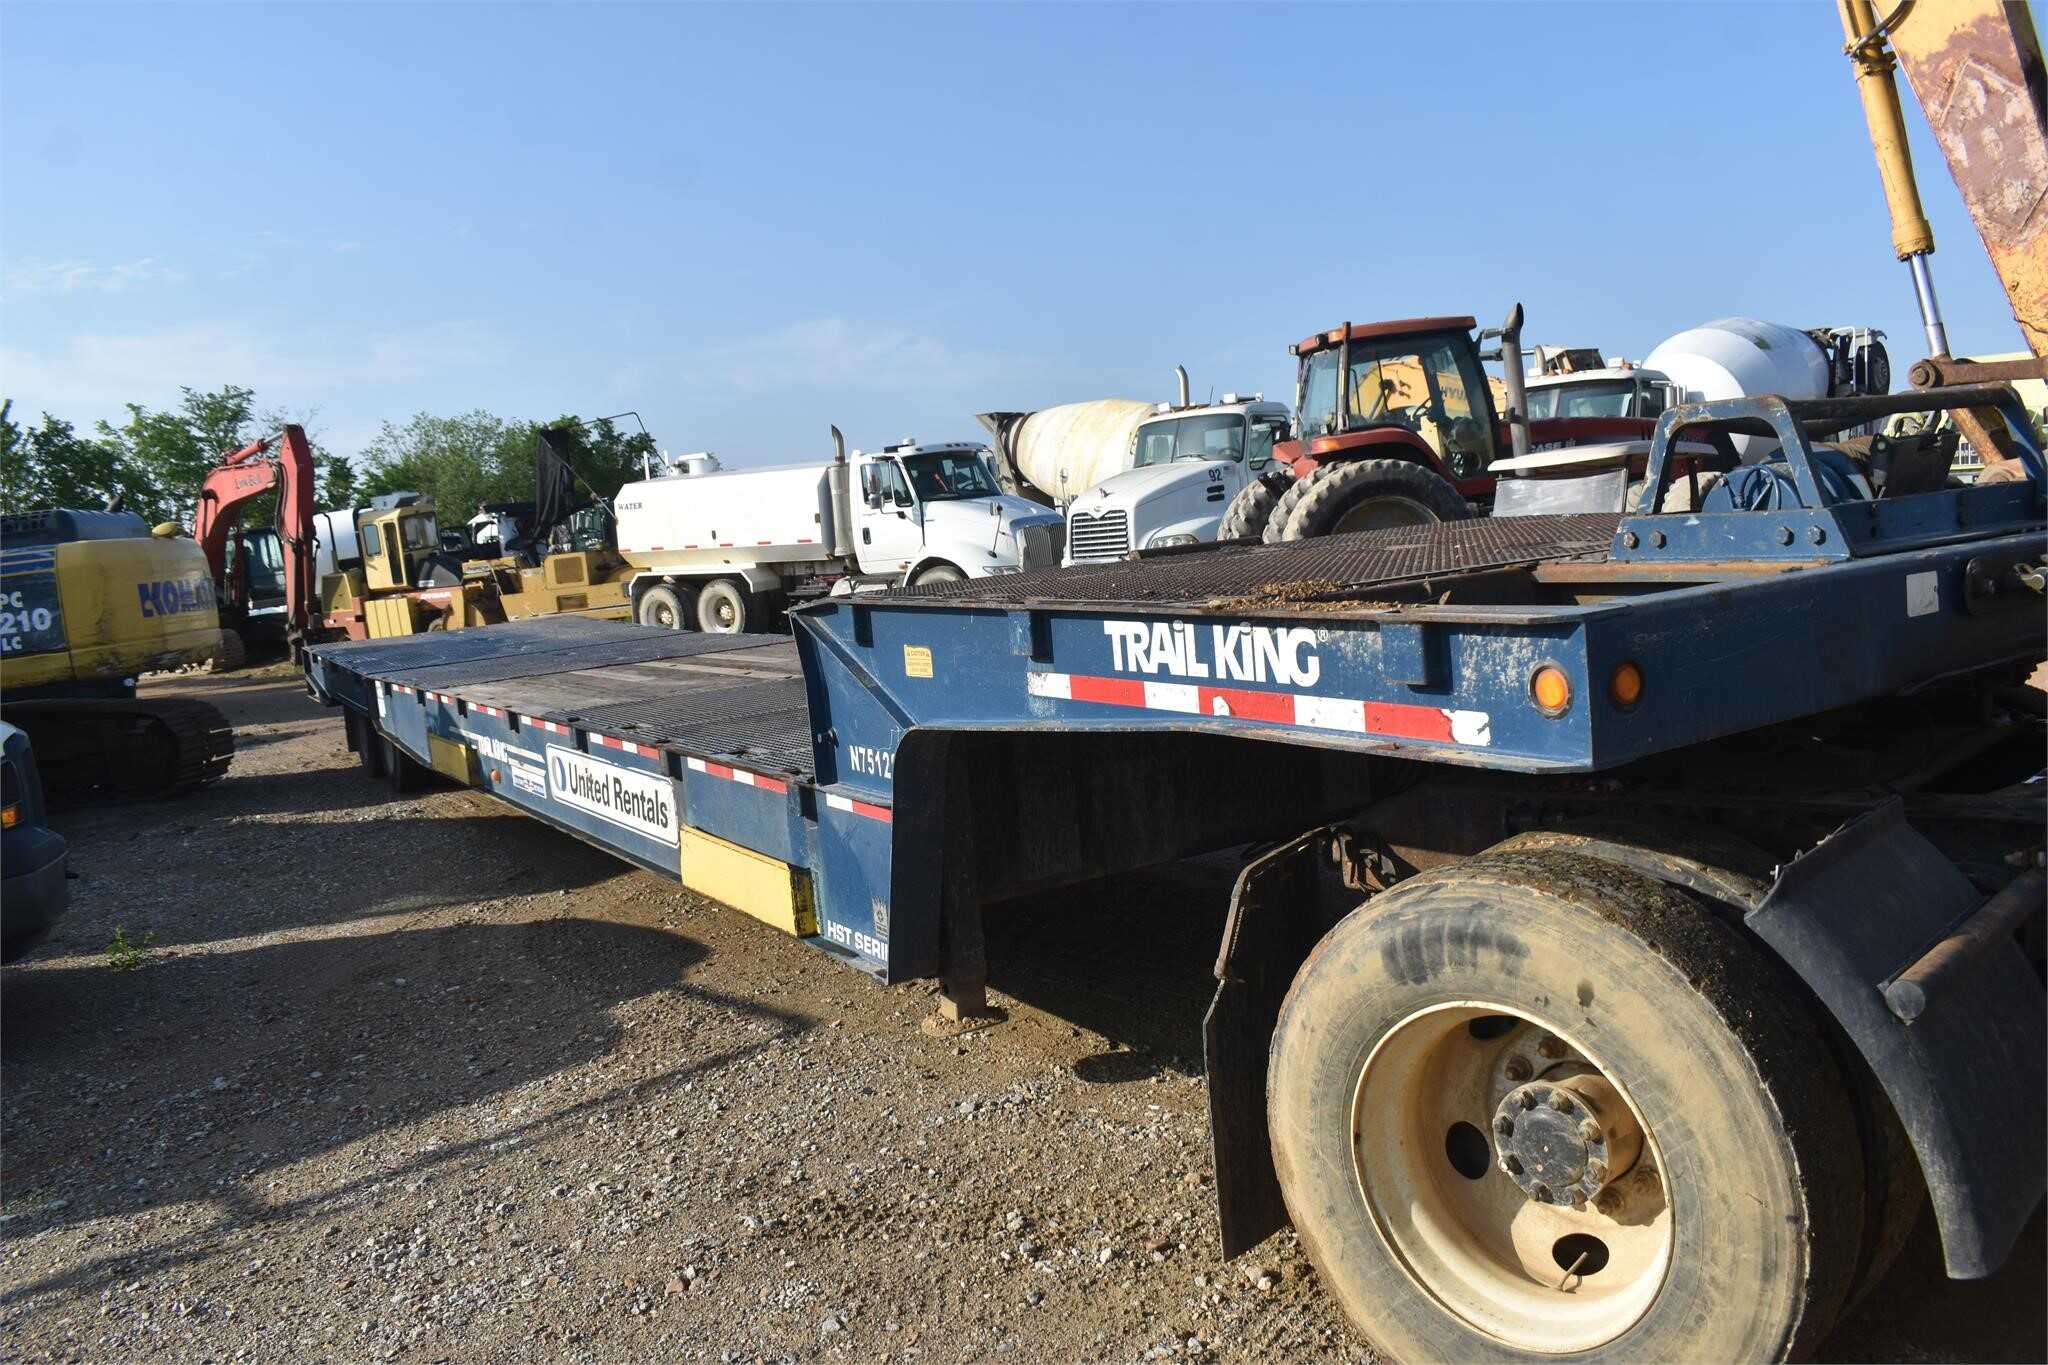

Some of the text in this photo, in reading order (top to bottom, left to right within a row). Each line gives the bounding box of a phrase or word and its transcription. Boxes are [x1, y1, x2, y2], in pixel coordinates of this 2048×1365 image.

[1208, 468, 1223, 482] 92
[617, 502, 643, 511] WATER
[0, 591, 24, 610] PC
[0, 607, 51, 635] 210
[1, 636, 23, 651] LC
[568, 761, 610, 807] United
[613, 776, 669, 829] Rentals
[827, 919, 852, 945] HST
